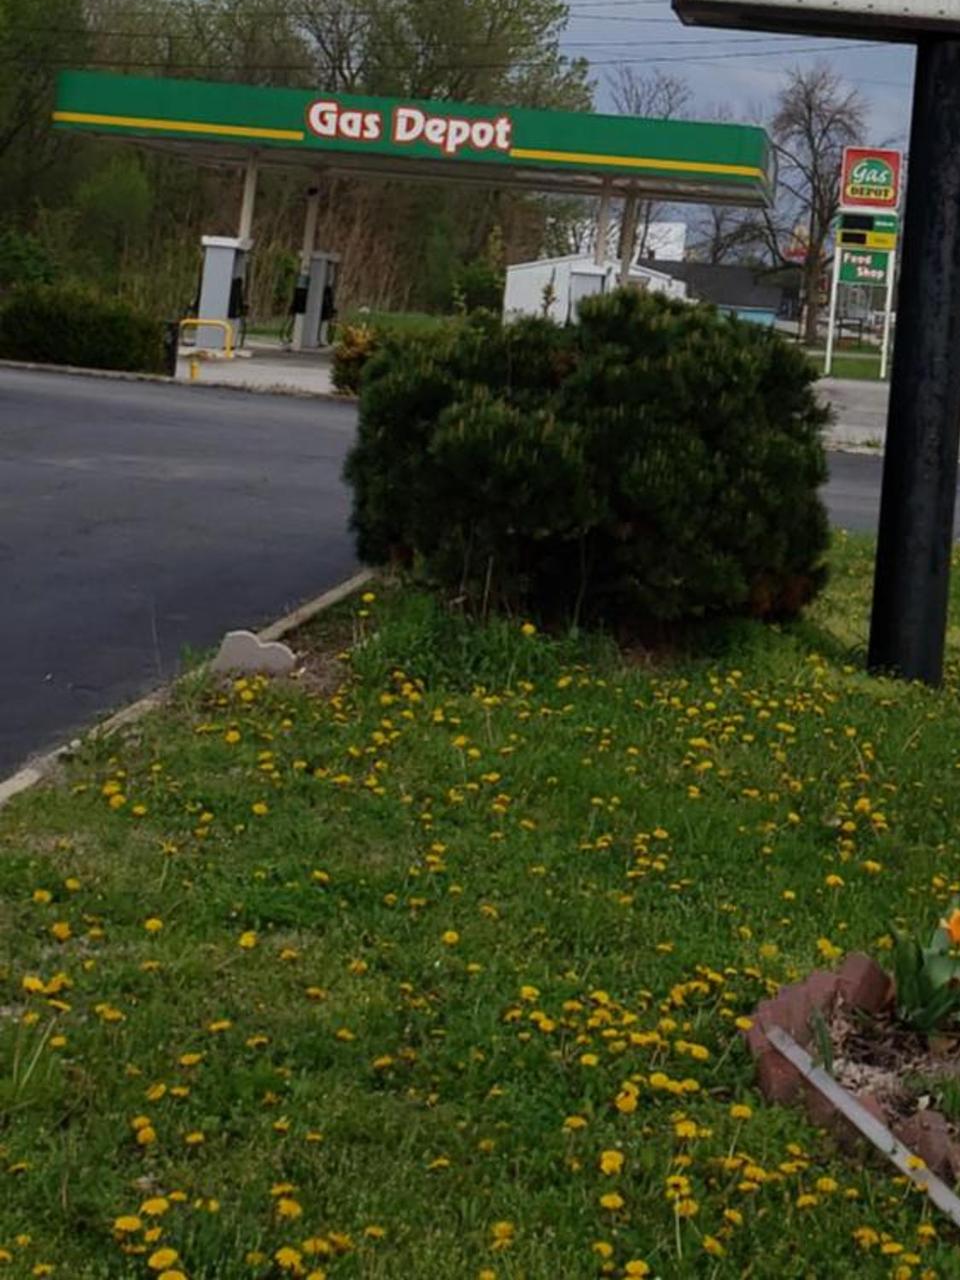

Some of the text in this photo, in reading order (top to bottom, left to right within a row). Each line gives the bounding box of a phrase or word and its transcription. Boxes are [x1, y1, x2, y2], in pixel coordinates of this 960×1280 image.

[308, 101, 512, 153] Gas Depot
[852, 161, 890, 184] Gas
